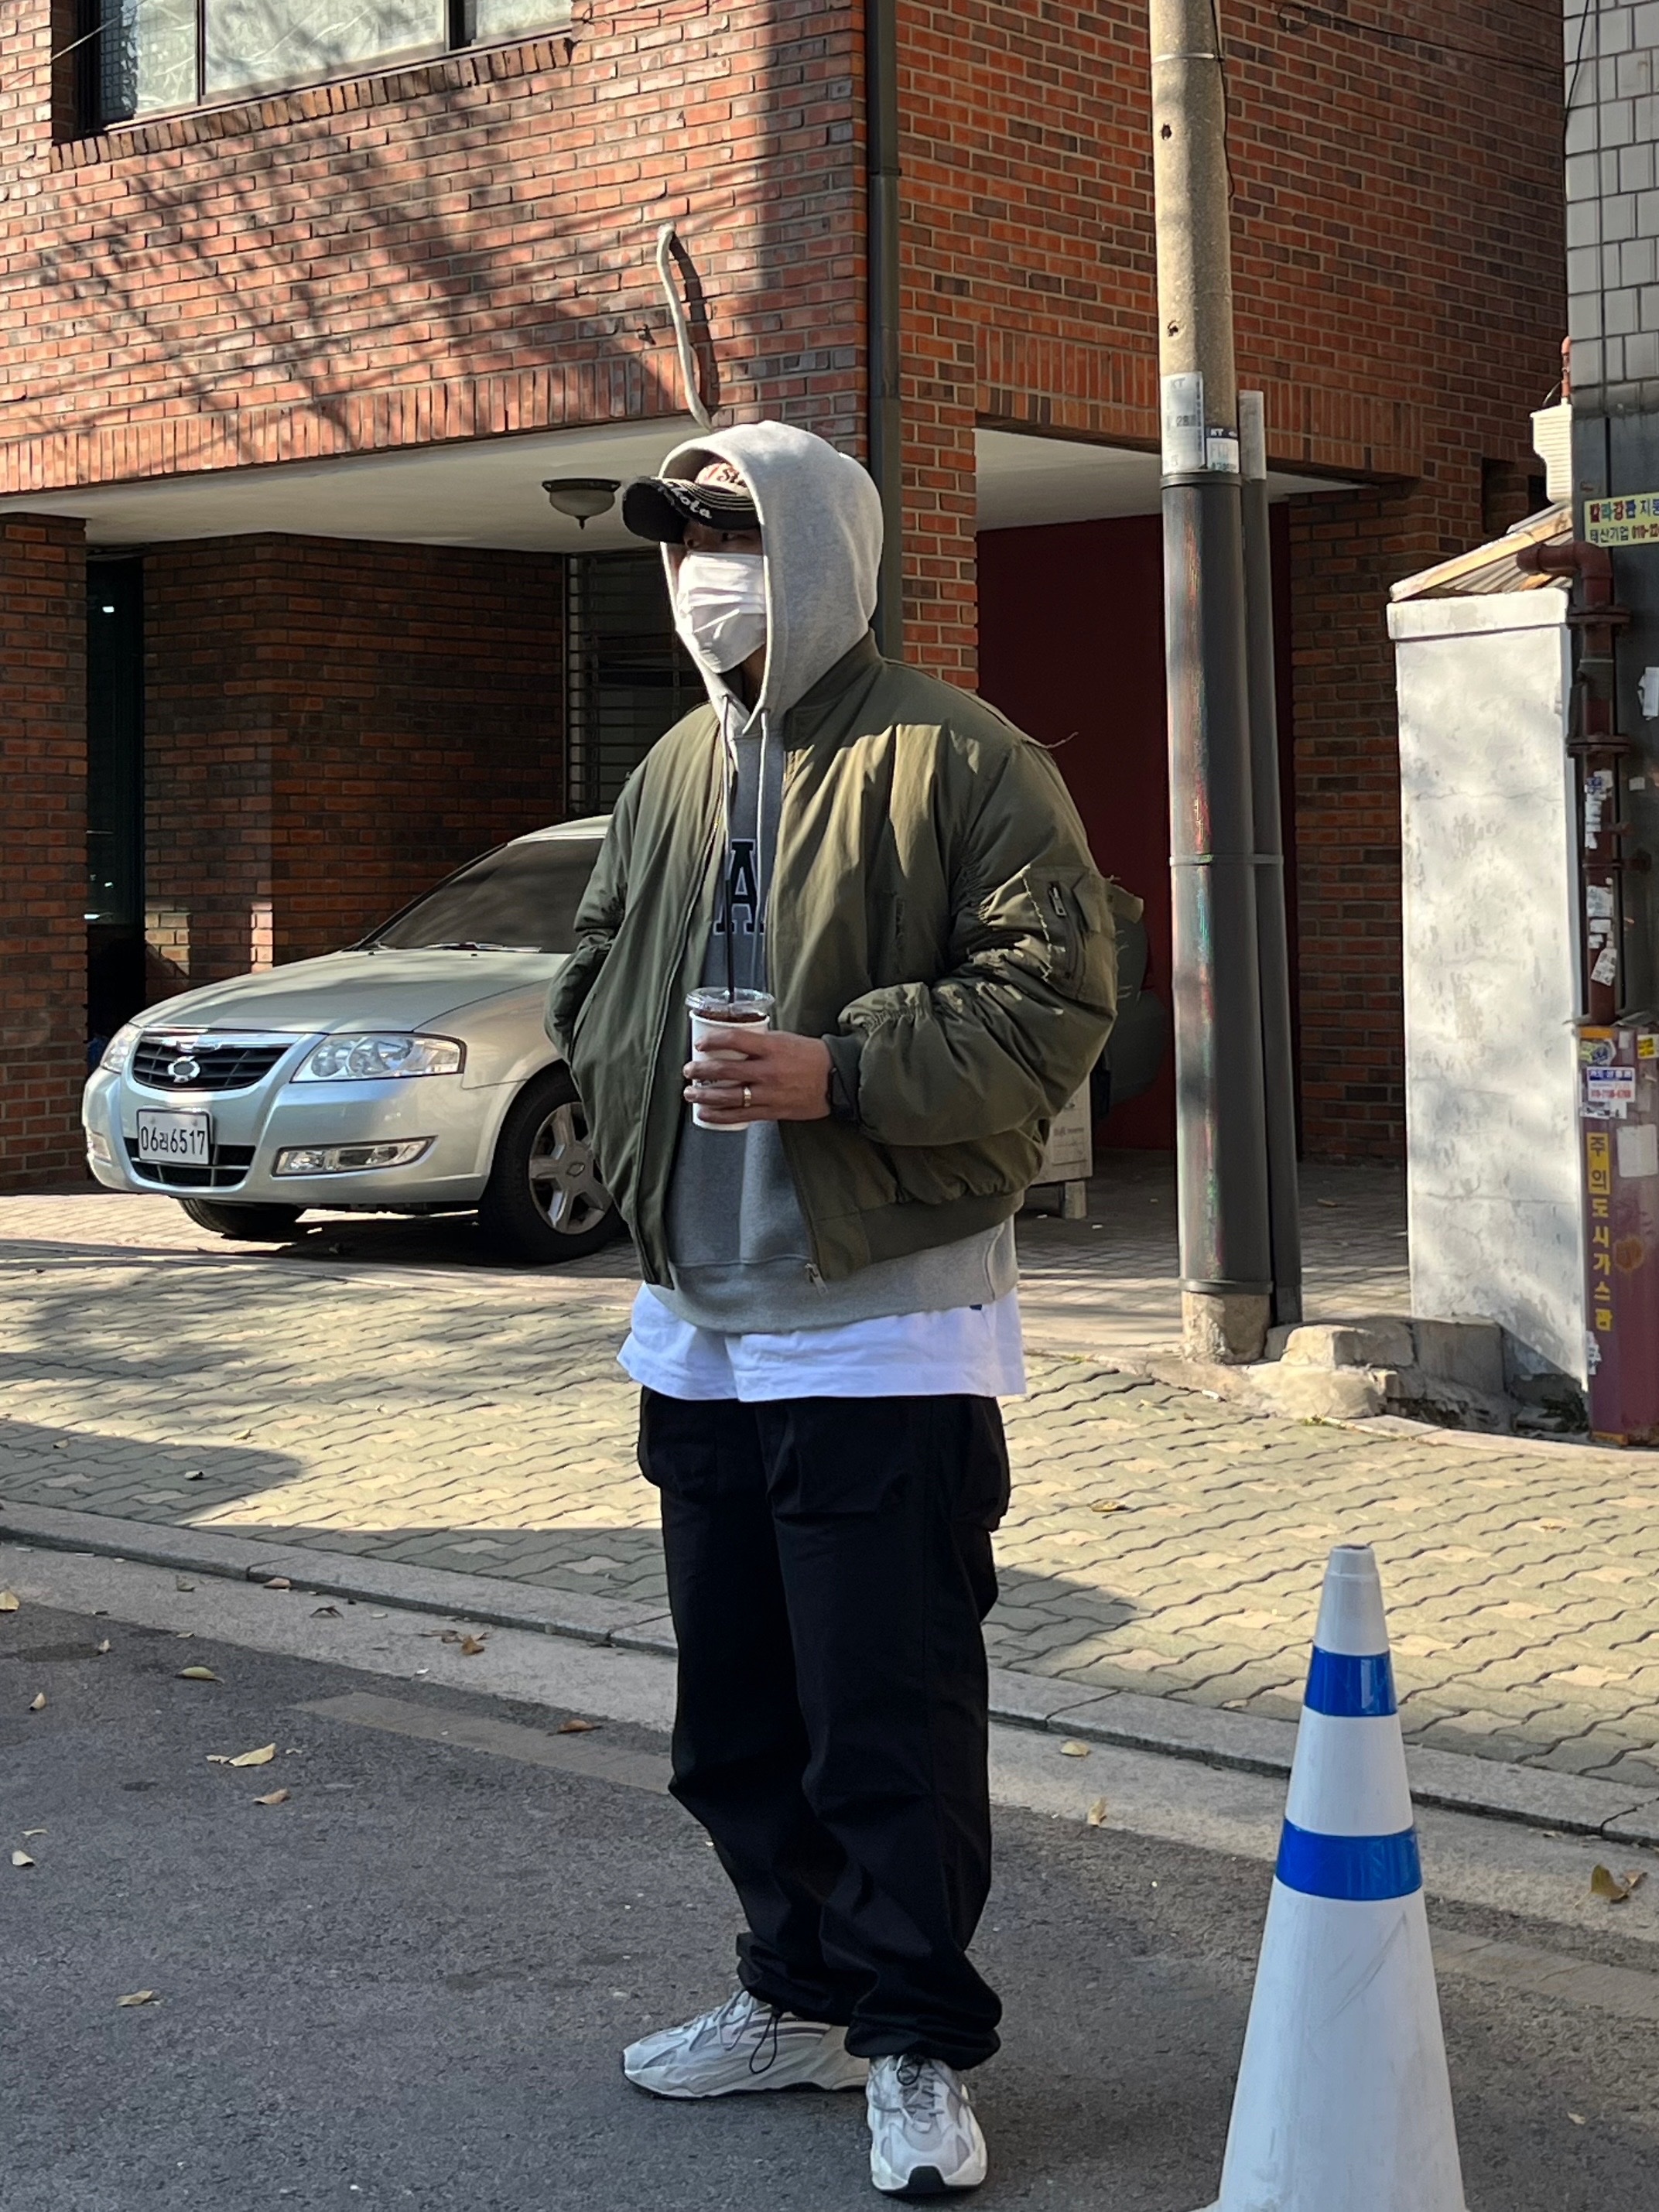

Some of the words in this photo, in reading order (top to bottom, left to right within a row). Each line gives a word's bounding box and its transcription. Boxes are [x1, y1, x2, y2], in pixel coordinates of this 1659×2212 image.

[1590, 526, 1629, 543] 태산기업
[713, 839, 765, 936] A
[1589, 1137, 1607, 1191] 주의
